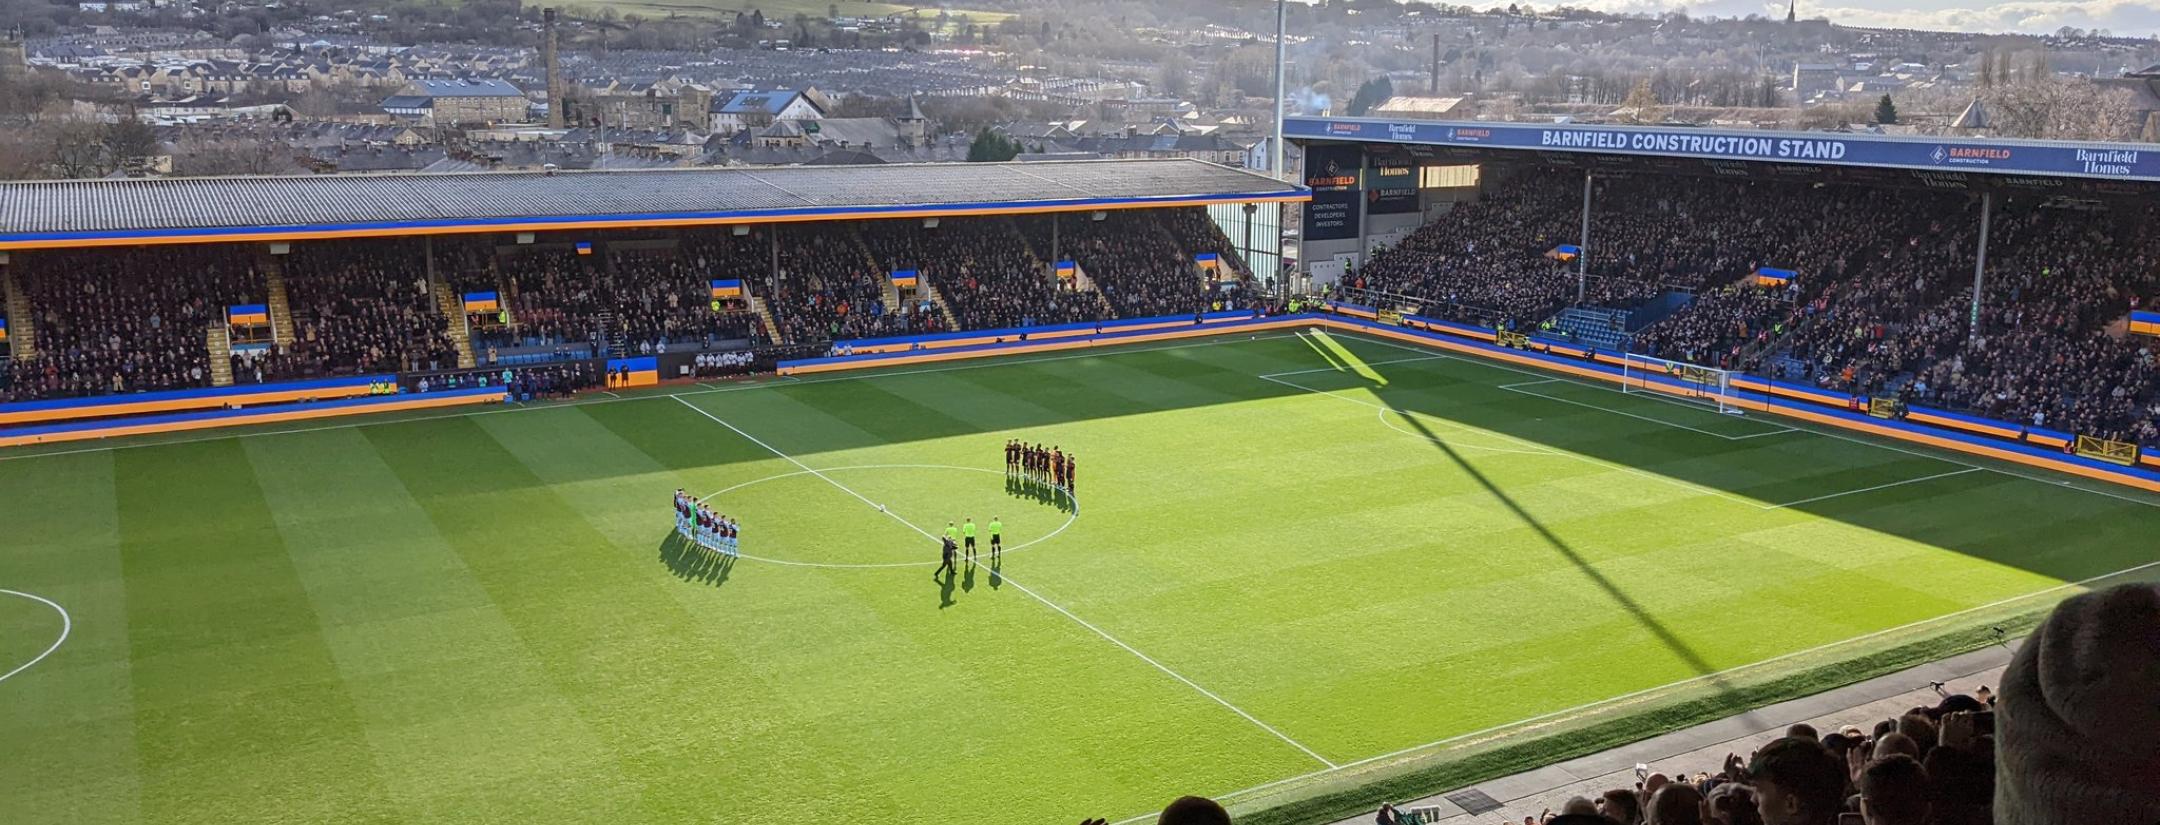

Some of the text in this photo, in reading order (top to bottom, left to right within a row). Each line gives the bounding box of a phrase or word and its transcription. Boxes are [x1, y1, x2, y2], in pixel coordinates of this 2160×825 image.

[1456, 128, 1490, 137] BARNFIELD
[1542, 130, 1845, 160] BARNFIELD CONSTRUCTION STAND
[1950, 148, 2011, 159] BARNFIELD
[2076, 149, 2138, 163] Barnfield
[1380, 166, 1409, 176] Homes
[2084, 161, 2131, 174] Homes
[1309, 175, 1355, 186] BARNFIELD
